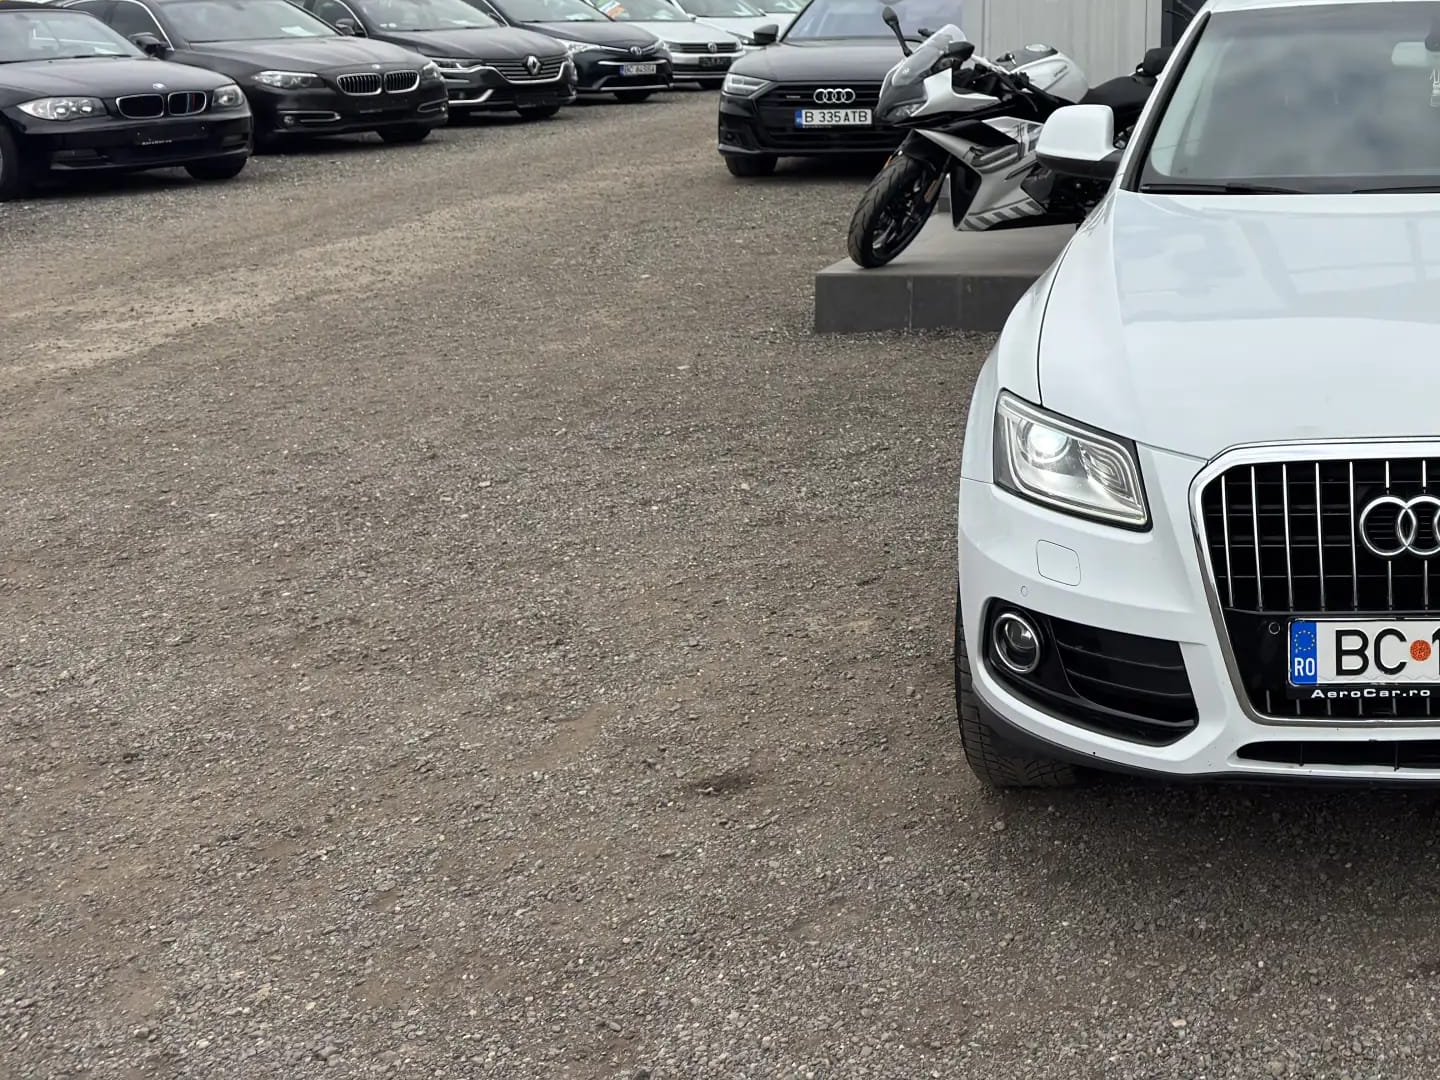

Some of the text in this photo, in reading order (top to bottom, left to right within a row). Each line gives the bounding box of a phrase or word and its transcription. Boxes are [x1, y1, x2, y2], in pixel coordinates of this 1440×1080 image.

[804, 111, 814, 123] B
[1294, 657, 1316, 677] RO
[1335, 627, 1408, 676] BC
[1311, 688, 1431, 698] AeroCar.ro
